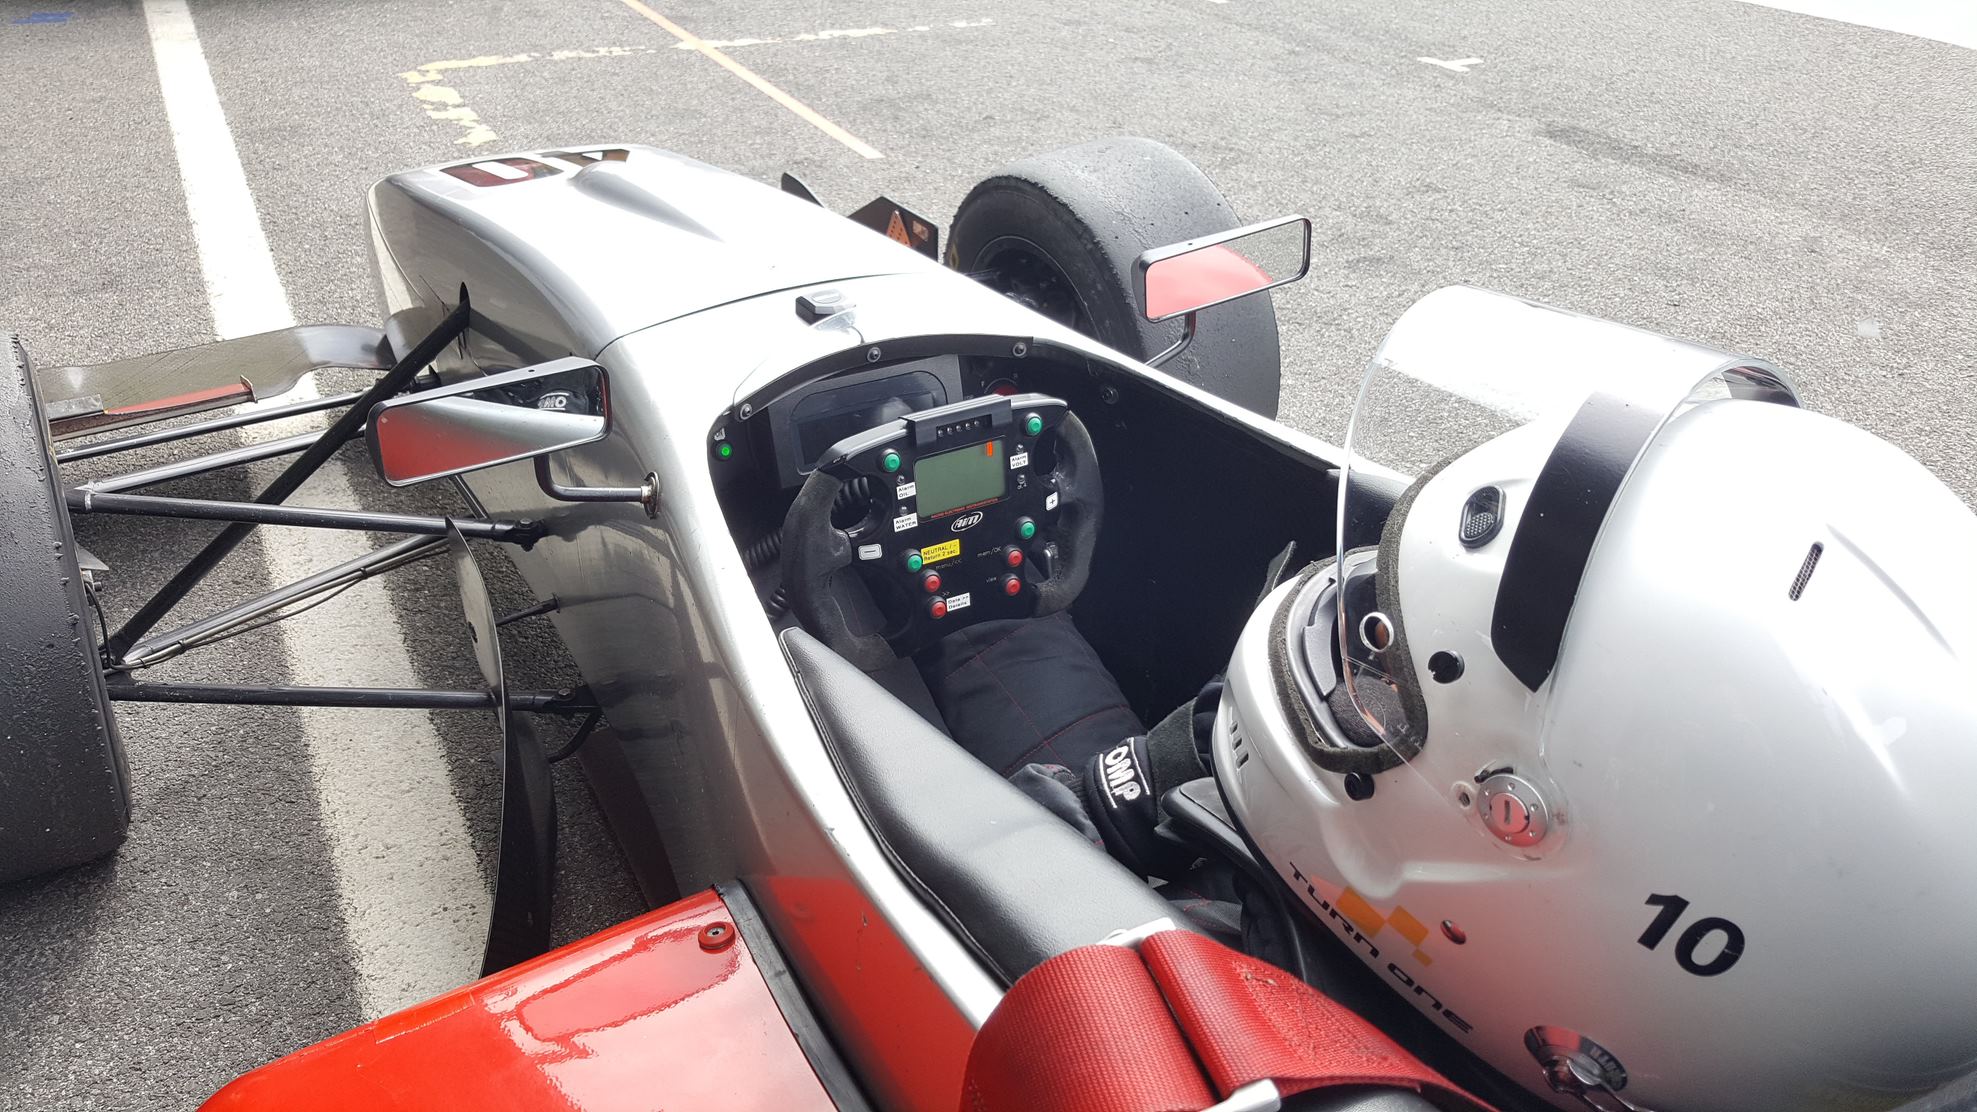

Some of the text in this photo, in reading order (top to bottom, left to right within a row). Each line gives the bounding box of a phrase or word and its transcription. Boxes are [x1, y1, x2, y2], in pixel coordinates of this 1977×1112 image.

[896, 521, 917, 530] WATER
[923, 545, 948, 556] NEUTRAL
[1103, 744, 1142, 802] OMP
[1637, 892, 1745, 978] 10
